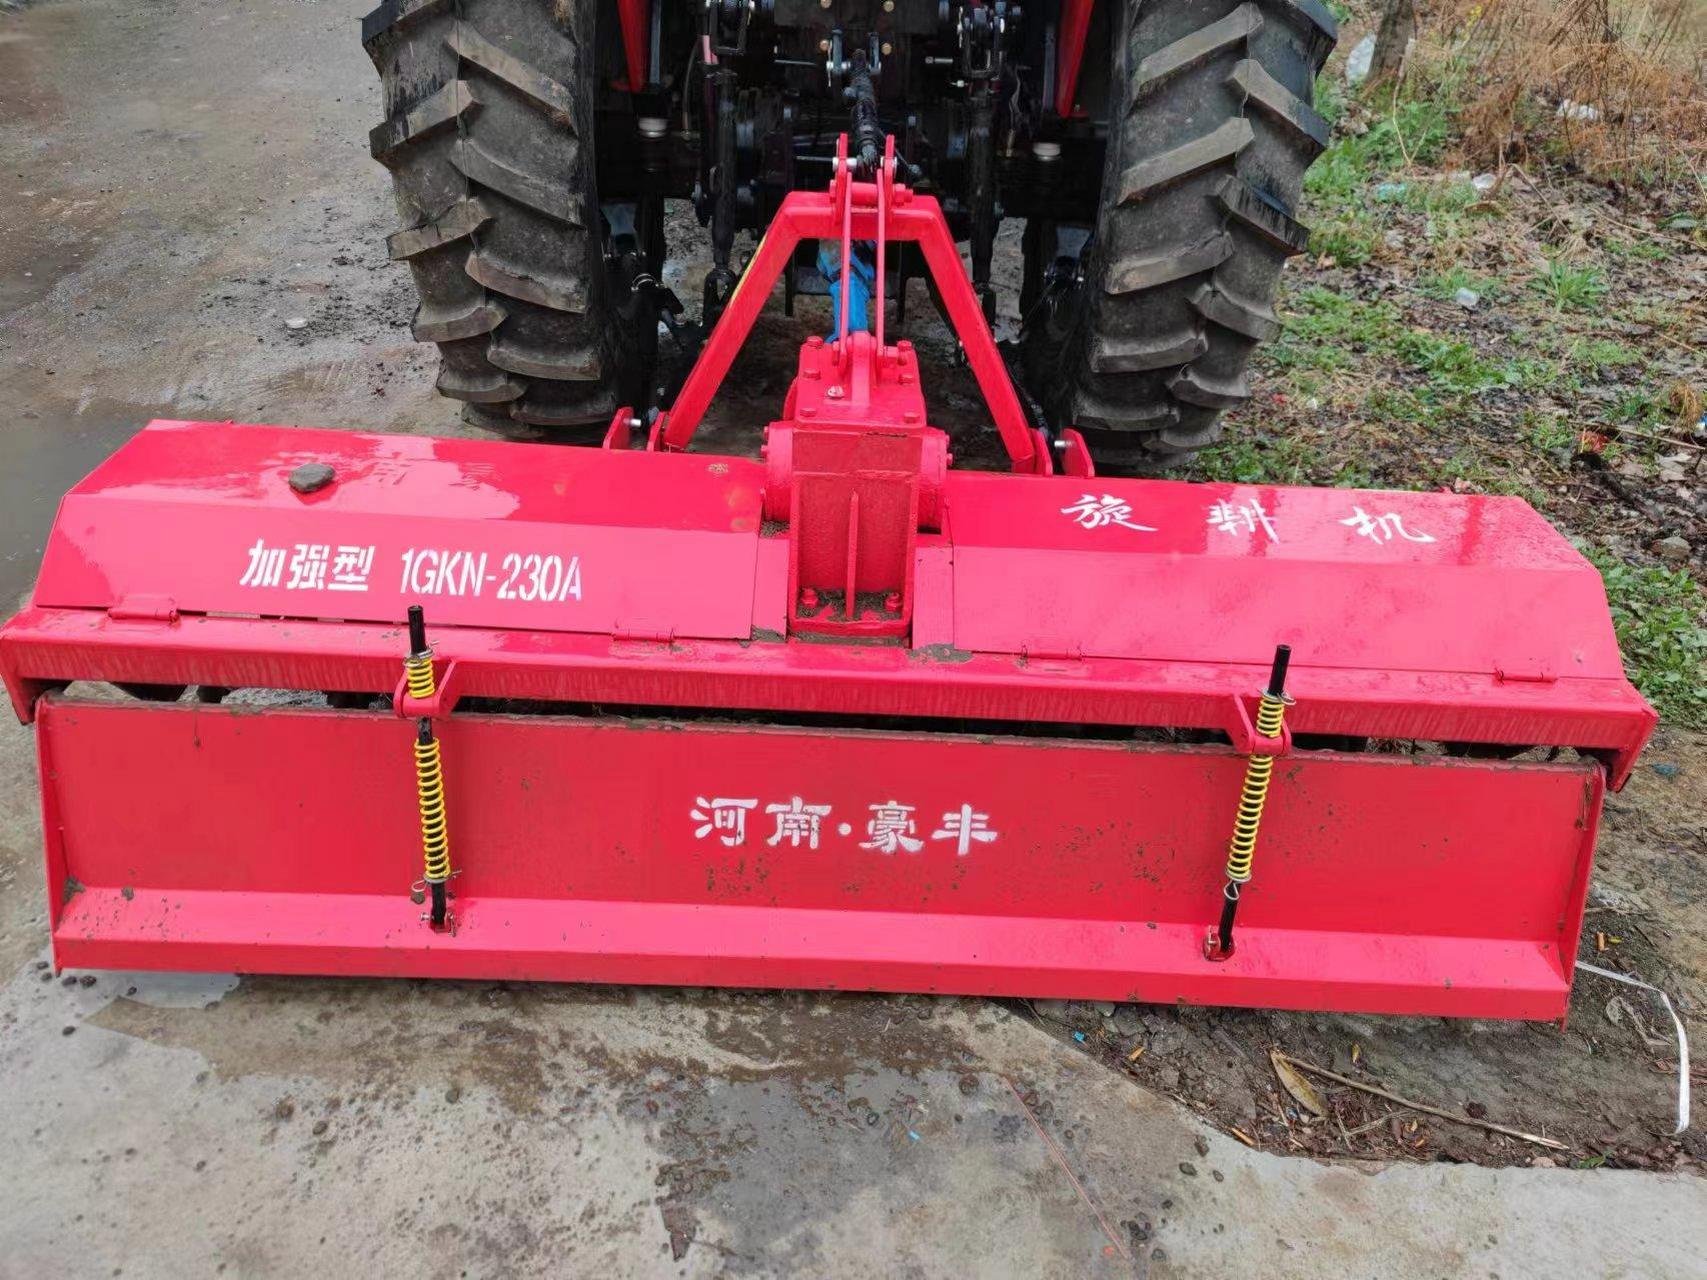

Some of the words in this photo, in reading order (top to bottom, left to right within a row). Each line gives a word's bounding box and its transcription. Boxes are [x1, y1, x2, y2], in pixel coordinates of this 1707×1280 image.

[1061, 493, 1437, 545] 旋耕机
[239, 538, 376, 592] 加强型
[400, 547, 582, 602] 1GKN-230A
